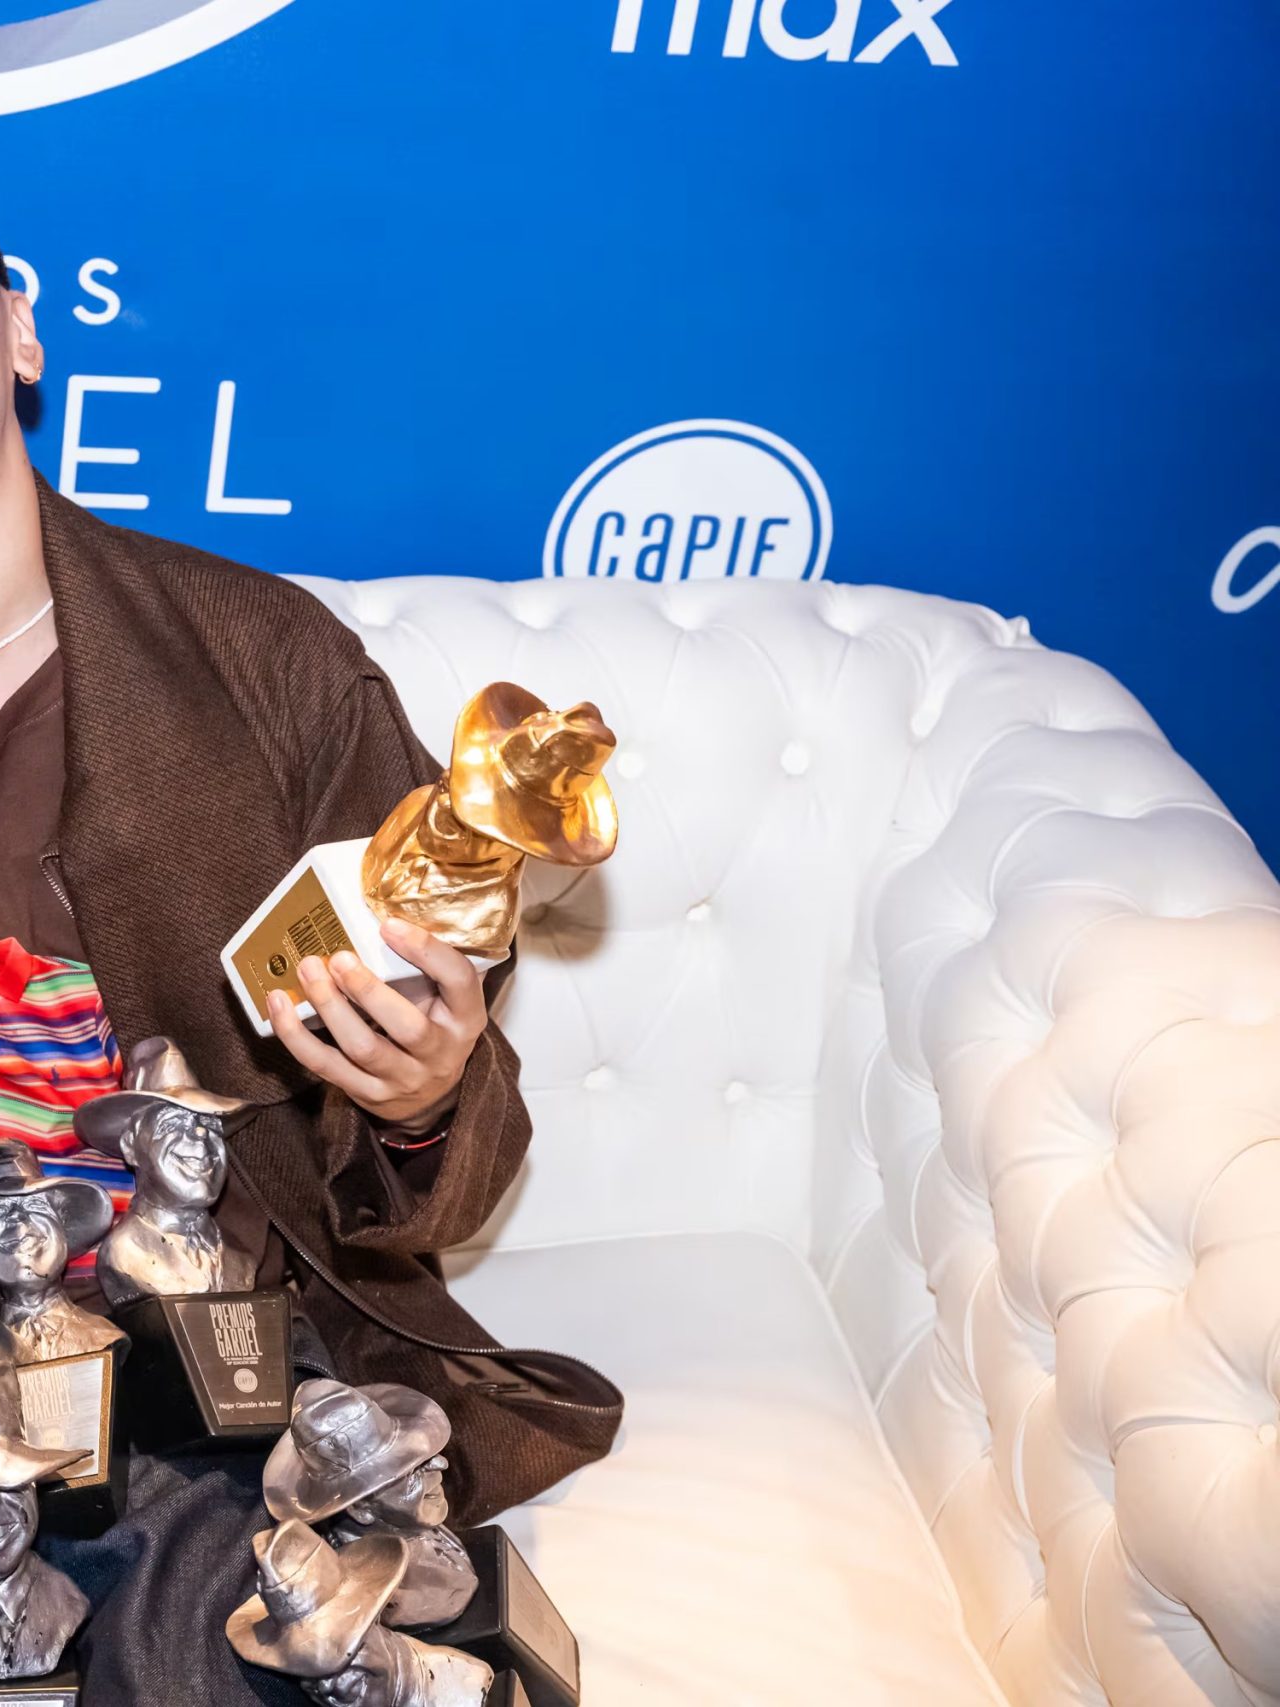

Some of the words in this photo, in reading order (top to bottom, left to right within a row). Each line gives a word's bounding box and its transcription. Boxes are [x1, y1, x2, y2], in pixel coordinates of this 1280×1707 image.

[287, 914, 327, 957] GARDE
[209, 1302, 257, 1329] PREMIOS
[214, 1326, 263, 1358] GARDEL
